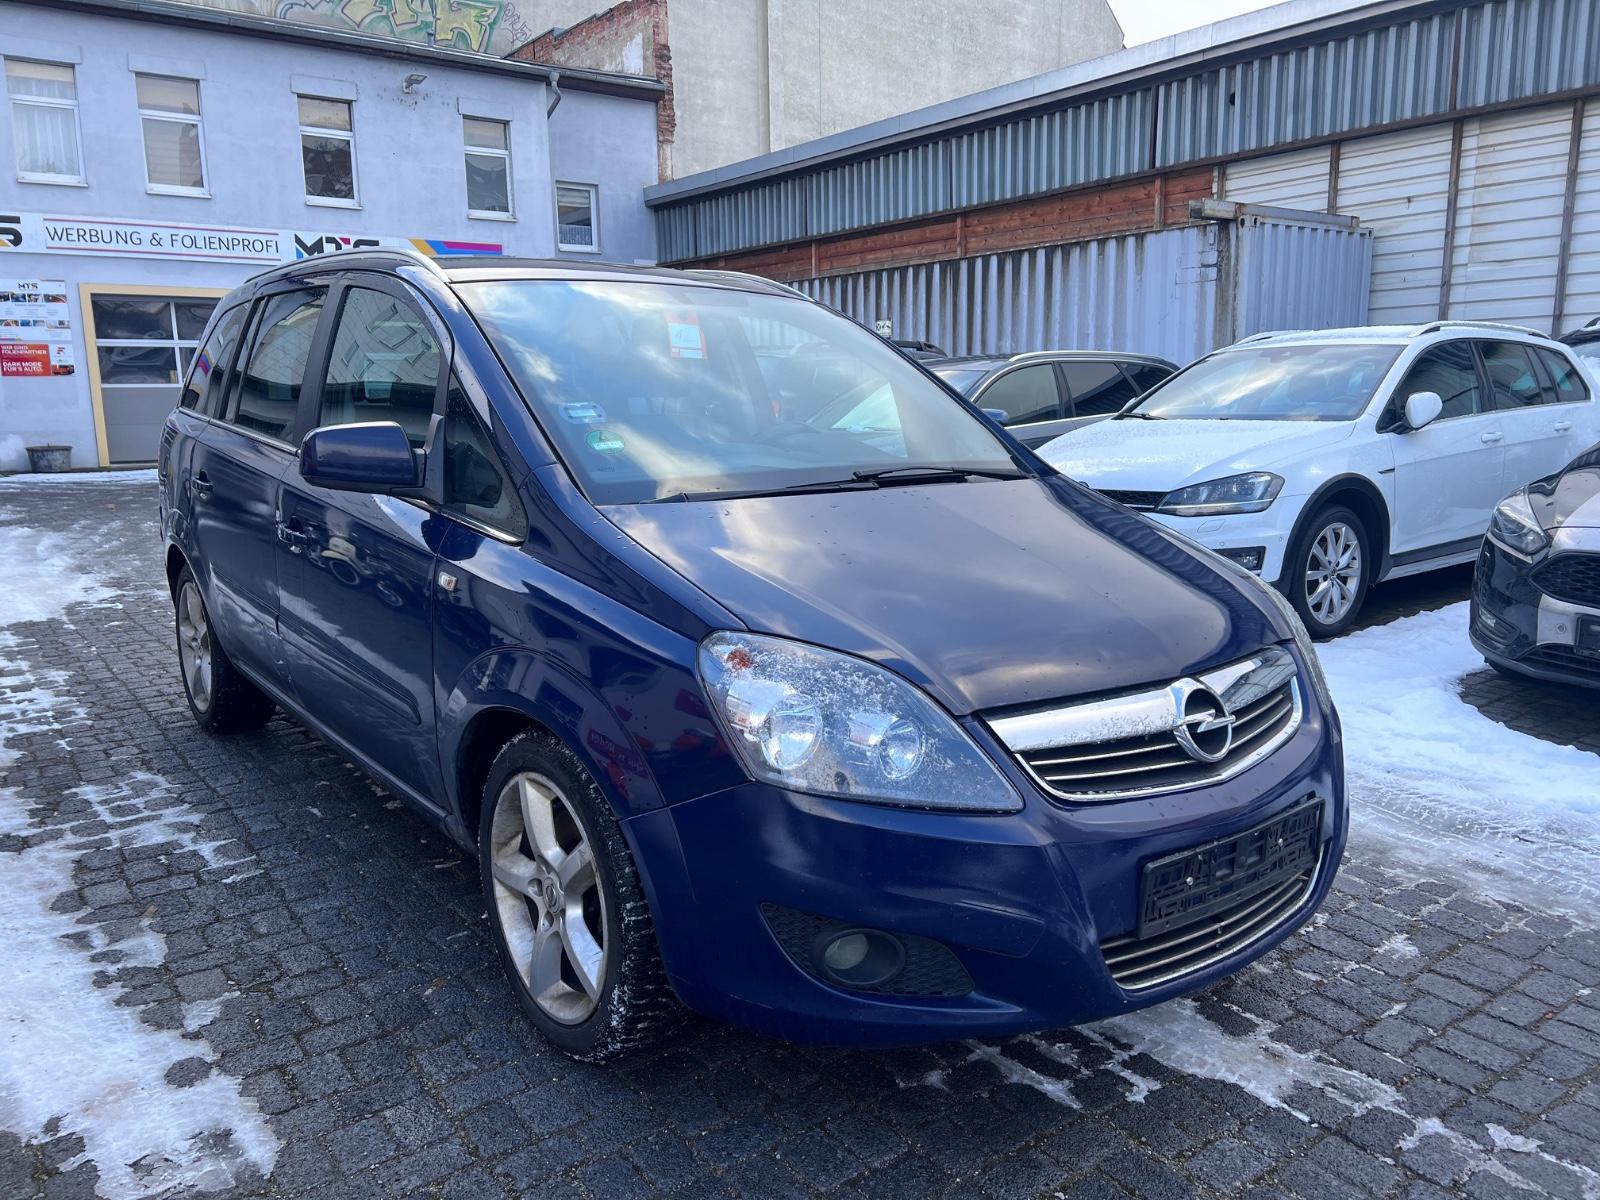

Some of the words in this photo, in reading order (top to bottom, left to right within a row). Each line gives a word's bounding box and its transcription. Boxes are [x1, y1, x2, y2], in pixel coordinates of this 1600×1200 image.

[45, 225, 142, 247] WERBUNG
[149, 232, 164, 247] &
[170, 233, 280, 254] FOLIENPROFI
